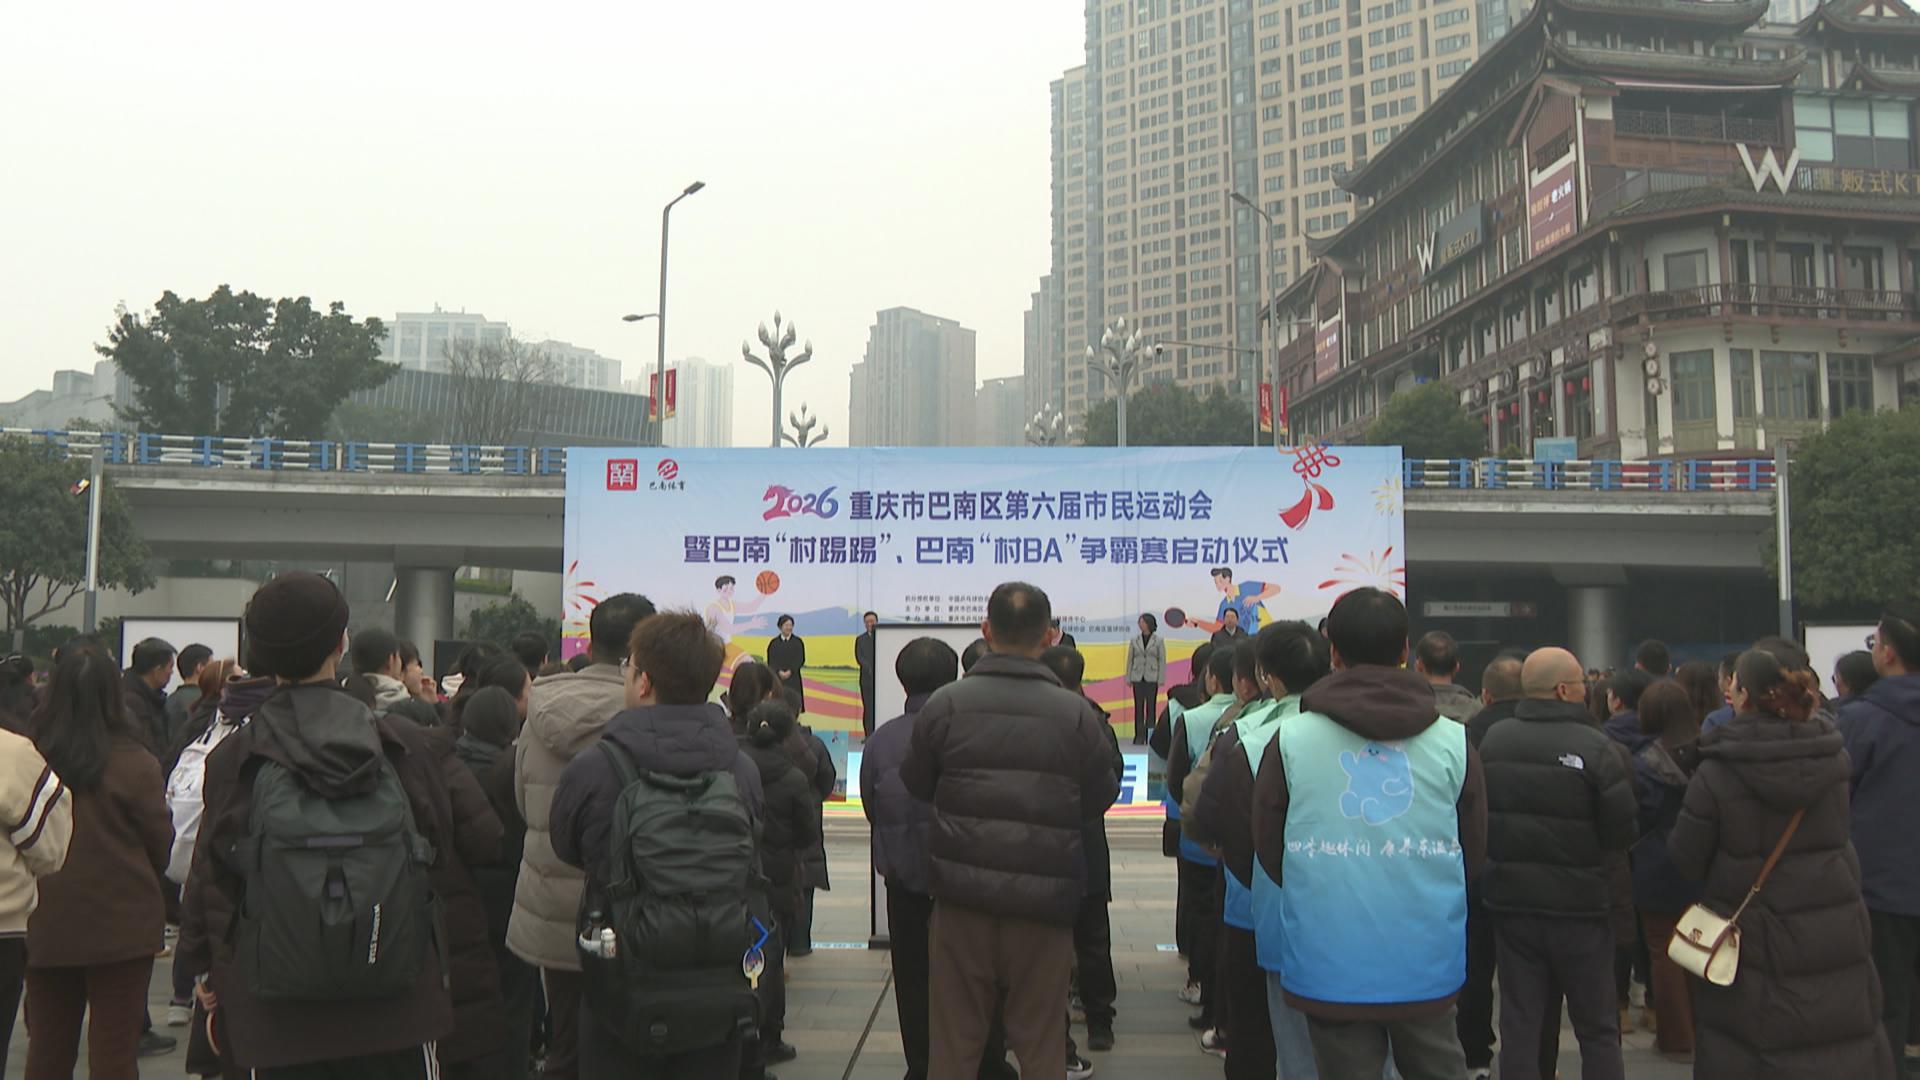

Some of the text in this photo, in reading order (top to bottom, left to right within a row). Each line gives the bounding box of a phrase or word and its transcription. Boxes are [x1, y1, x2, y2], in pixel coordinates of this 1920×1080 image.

[1735, 143, 1800, 195] W
[1416, 231, 1436, 276] W
[649, 480, 686, 492] 巴南体育
[762, 484, 1213, 522] 2026 重庆市巴南区第六届市民运动会
